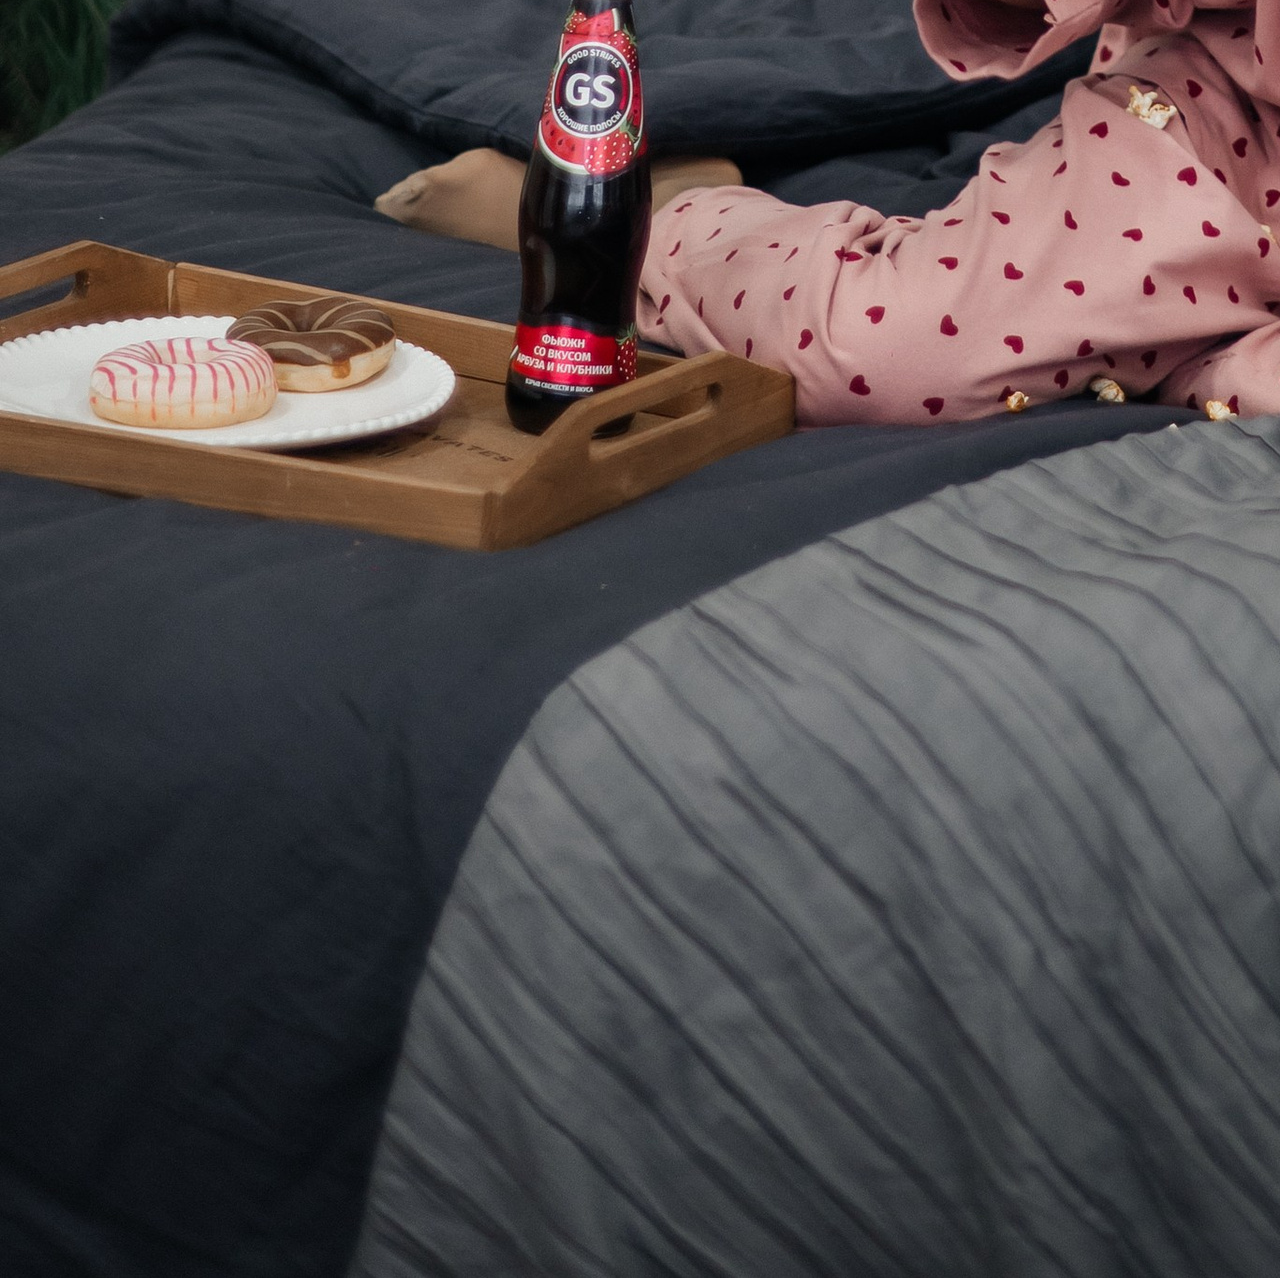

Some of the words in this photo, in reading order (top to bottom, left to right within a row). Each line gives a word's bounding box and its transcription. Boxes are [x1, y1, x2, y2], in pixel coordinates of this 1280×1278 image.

[567, 49, 589, 65] GOOD
[590, 48, 621, 69] STRIPES
[565, 72, 616, 109] GS
[557, 106, 589, 132] ХОРОШИЕ
[589, 110, 622, 133] ПОЛОСЫ
[541, 334, 585, 349] ФЬЮЖН
[516, 352, 545, 370] АРБУЗА
[546, 361, 554, 372] И
[556, 363, 613, 375] КЛУБНИКИ
[533, 345, 546, 357] СО
[547, 349, 591, 362] ВКУСОМ
